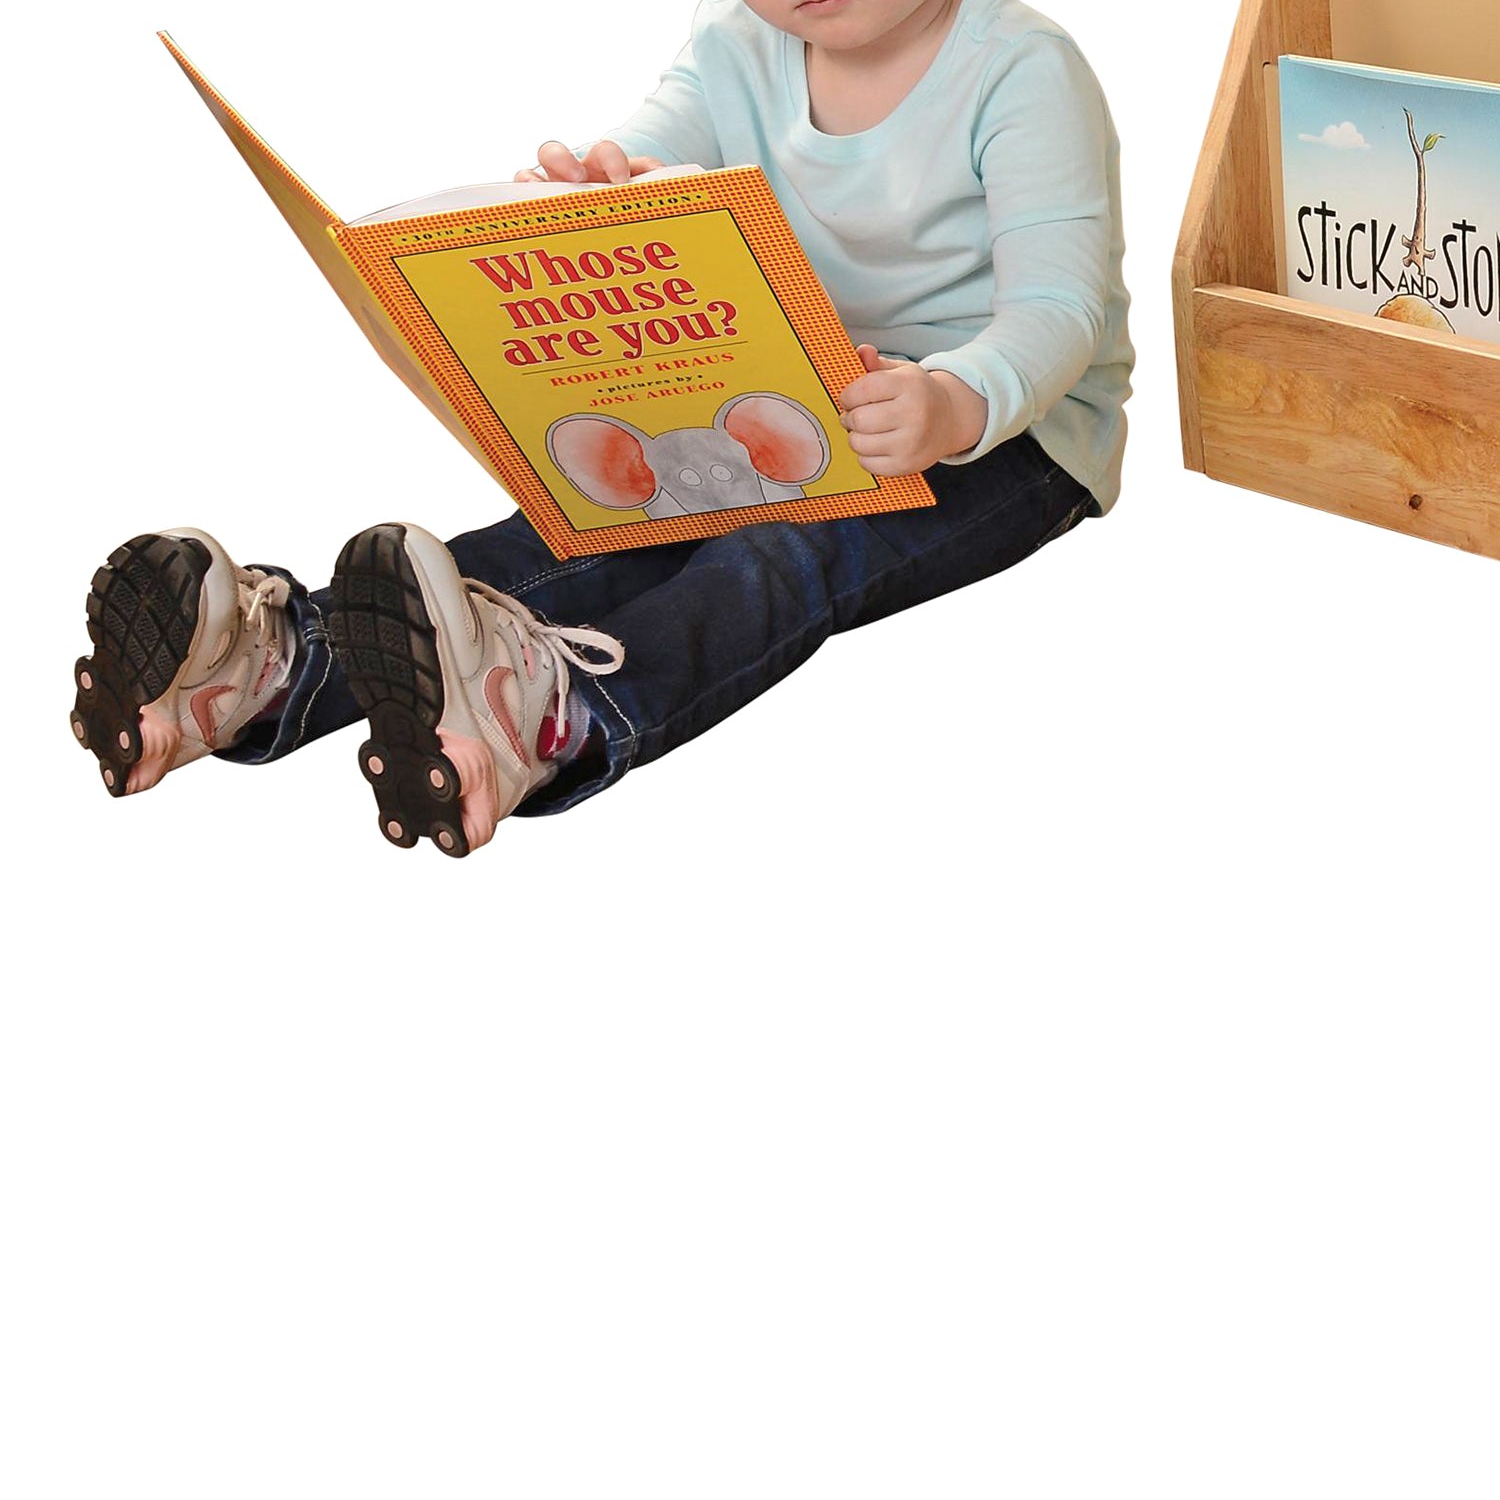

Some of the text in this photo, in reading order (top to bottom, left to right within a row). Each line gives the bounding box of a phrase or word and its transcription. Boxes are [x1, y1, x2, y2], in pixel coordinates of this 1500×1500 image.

[463, 208, 598, 235] ANNIVERSARY
[608, 195, 692, 214] EDITION
[468, 239, 680, 295] Whose
[1397, 270, 1439, 299] AND
[499, 276, 699, 330] mouse
[501, 300, 739, 367] are you?
[549, 351, 736, 388] ROBERT KRAUS
[607, 374, 694, 394] pictures by
[589, 380, 727, 408] JOSE ARUEGO
